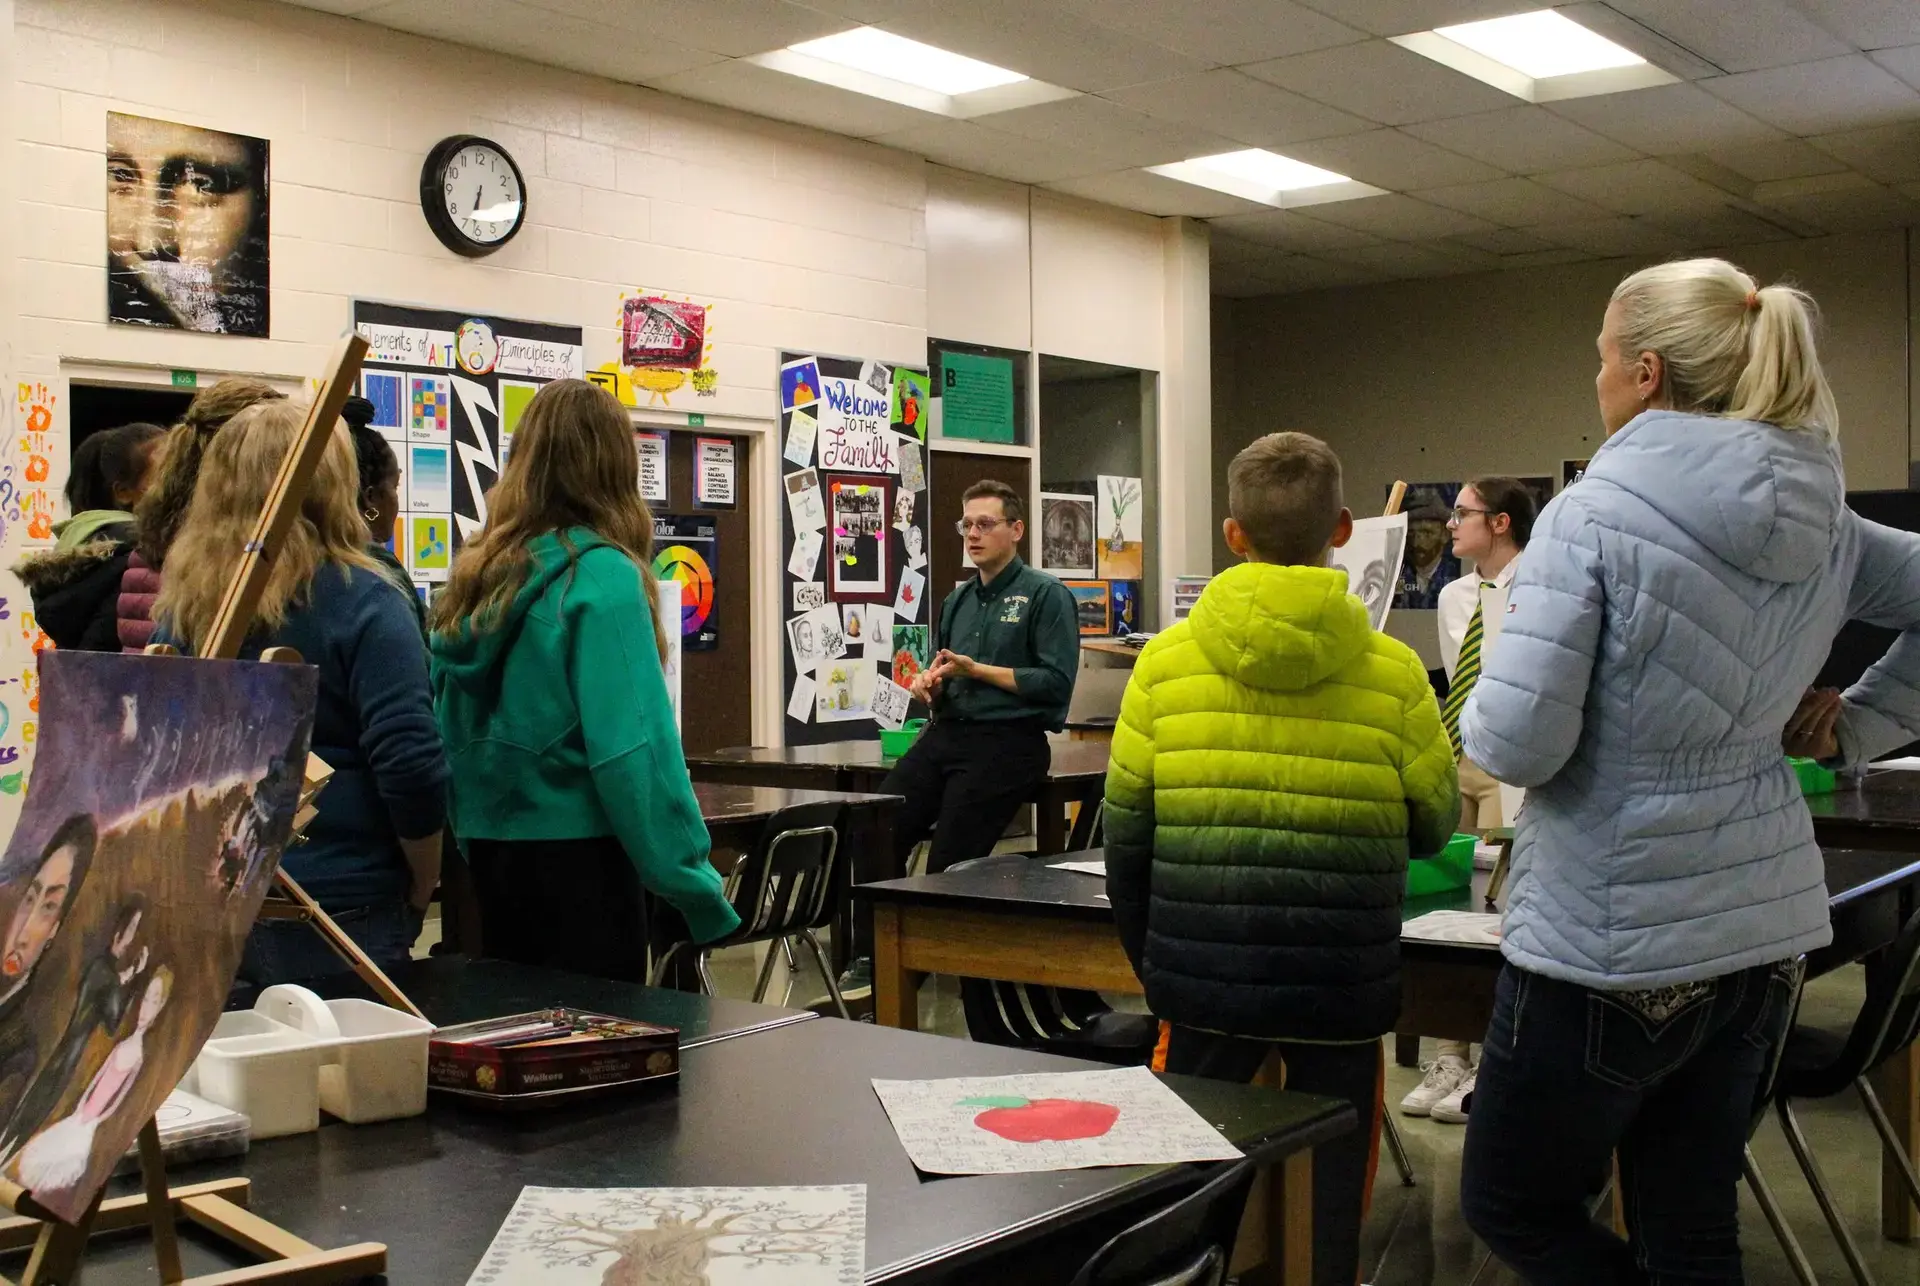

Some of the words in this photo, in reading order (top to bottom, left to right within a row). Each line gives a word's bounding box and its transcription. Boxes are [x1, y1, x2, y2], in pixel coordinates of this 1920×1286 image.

[460, 155, 467, 168] 11
[475, 152, 485, 165] 12
[449, 166, 459, 179] 10
[499, 175, 507, 187] 2
[445, 183, 453, 195] 9
[450, 202, 457, 215] 8
[461, 218, 469, 229] 7
[489, 222, 497, 234] 5
[474, 225, 482, 237] 6
[418, 331, 429, 358] of
[498, 338, 555, 368] Principles
[560, 346, 574, 372] of
[945, 367, 957, 387] B
[824, 380, 888, 418] Welcome
[843, 417, 857, 431] TO
[858, 419, 878, 434] THE
[412, 431, 431, 439] Shape
[824, 426, 894, 474] Family
[655, 522, 676, 536] olor
[523, 1073, 564, 1084] Walkers
